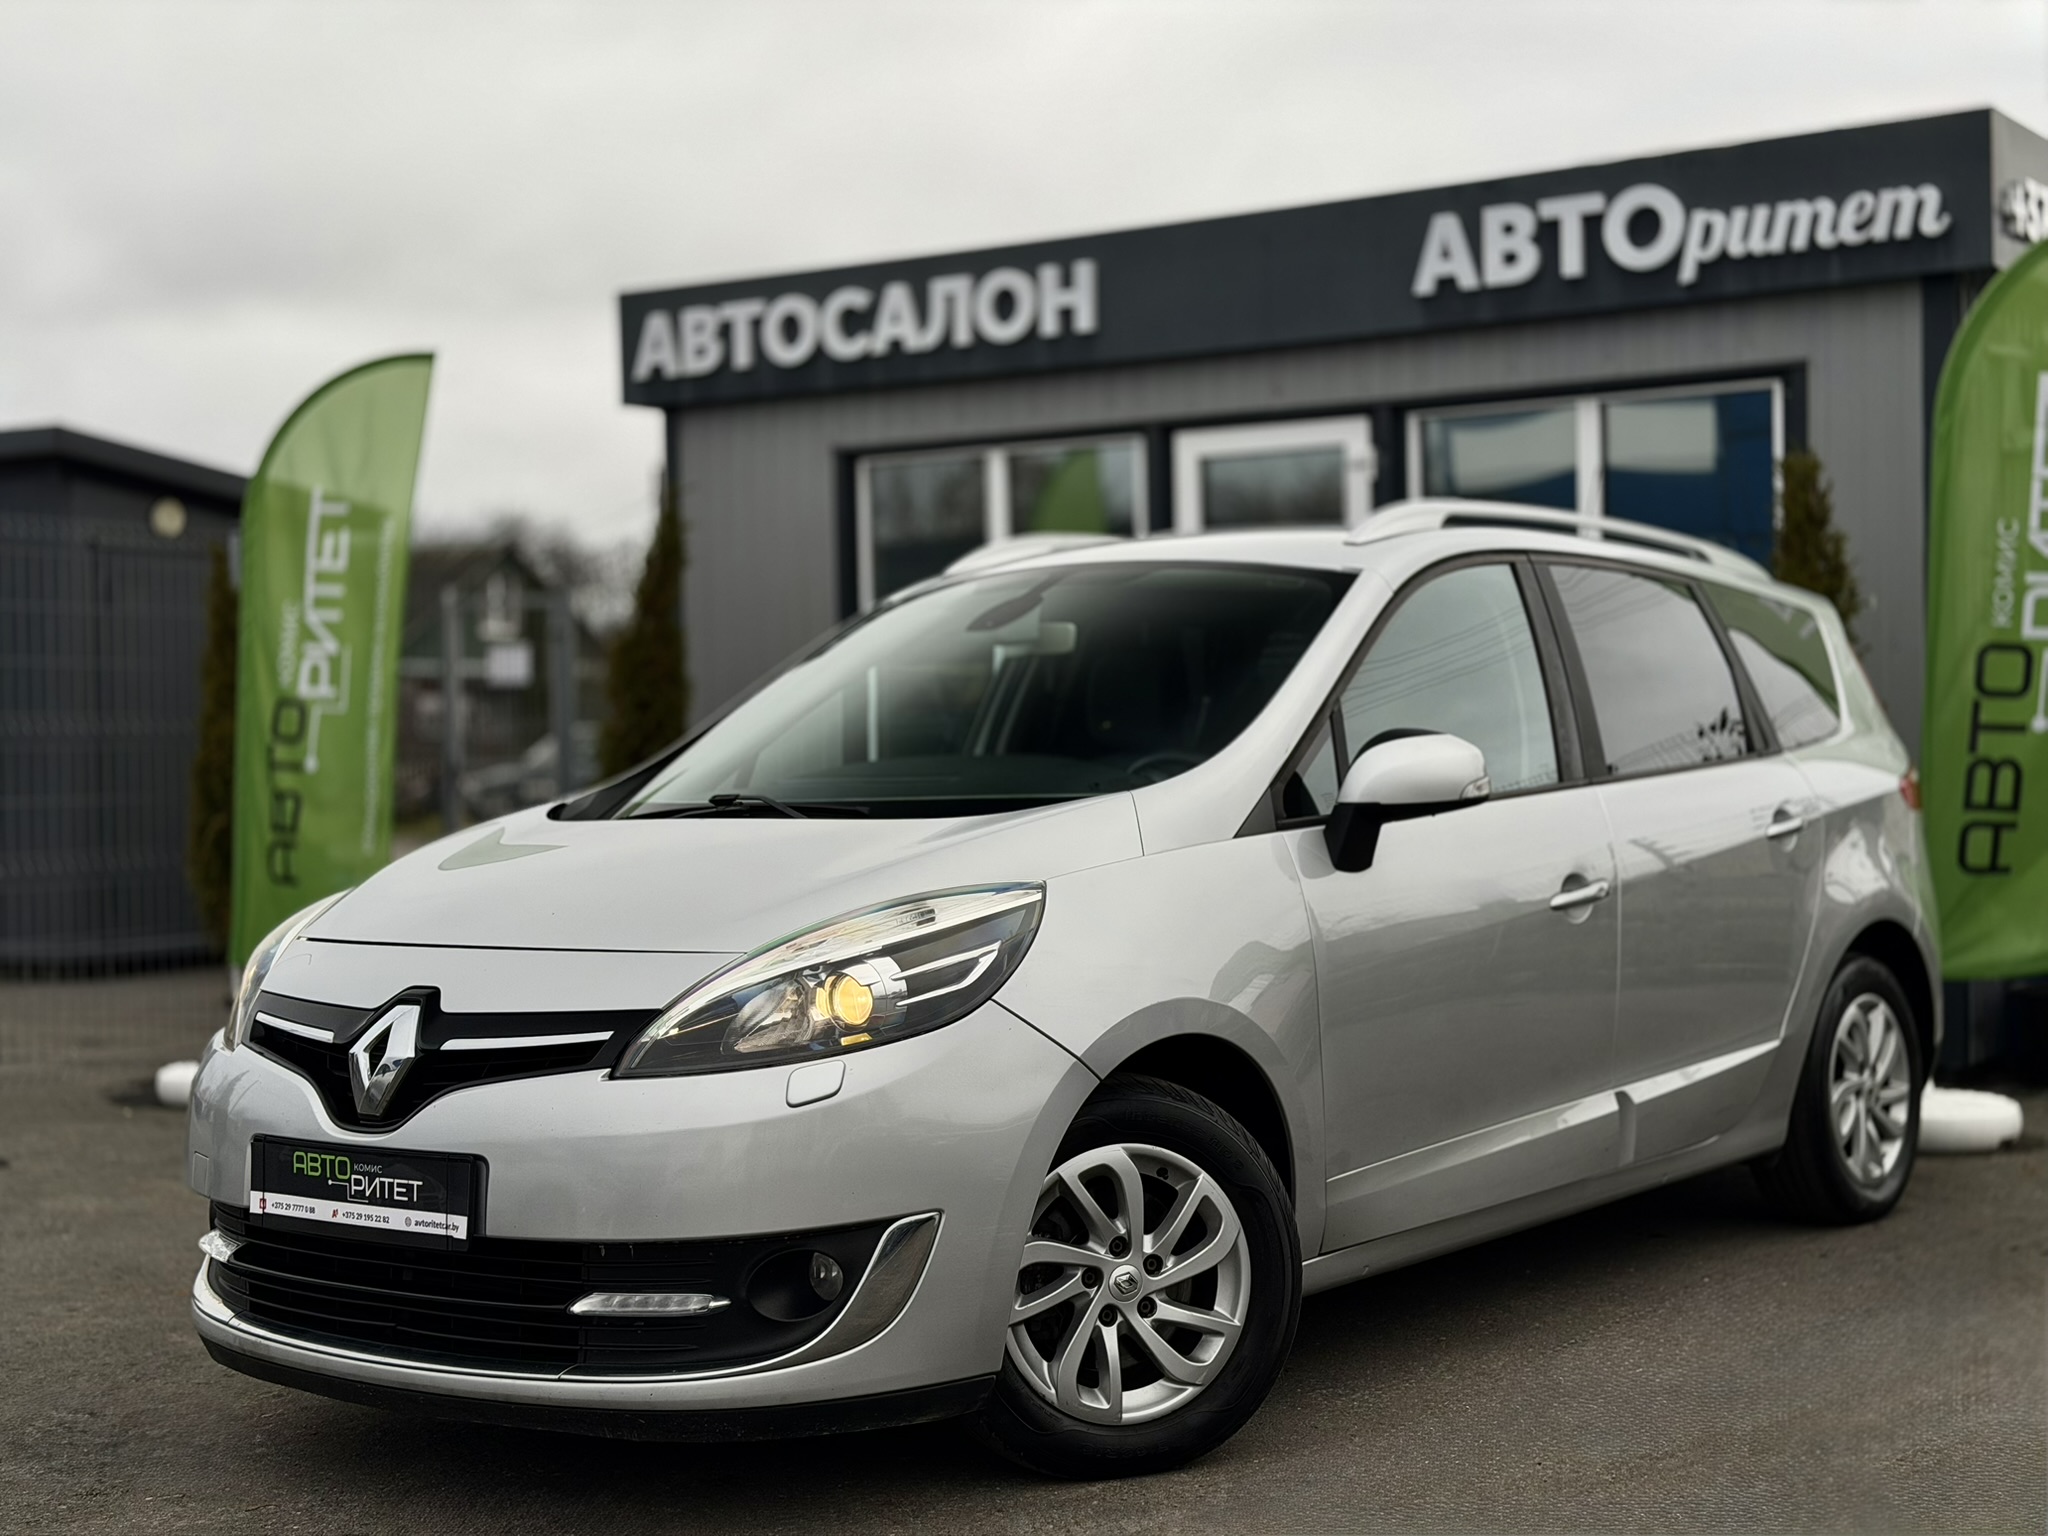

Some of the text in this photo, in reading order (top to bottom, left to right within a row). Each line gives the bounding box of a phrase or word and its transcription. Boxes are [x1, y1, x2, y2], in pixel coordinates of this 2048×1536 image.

[631, 258, 1098, 382] АВТОСАЛОН
[297, 483, 351, 700] РИТЕТ
[1957, 642, 2033, 876] АВТО
[266, 698, 308, 888] АВТО
[293, 1151, 351, 1180] АВТО
[353, 1163, 383, 1174] КОМИС
[351, 1174, 423, 1202] РИТЕТ
[271, 1201, 284, 1210] +375
[284, 1202, 291, 1211] 29
[342, 1211, 390, 1224] +375 29 195 22 82
